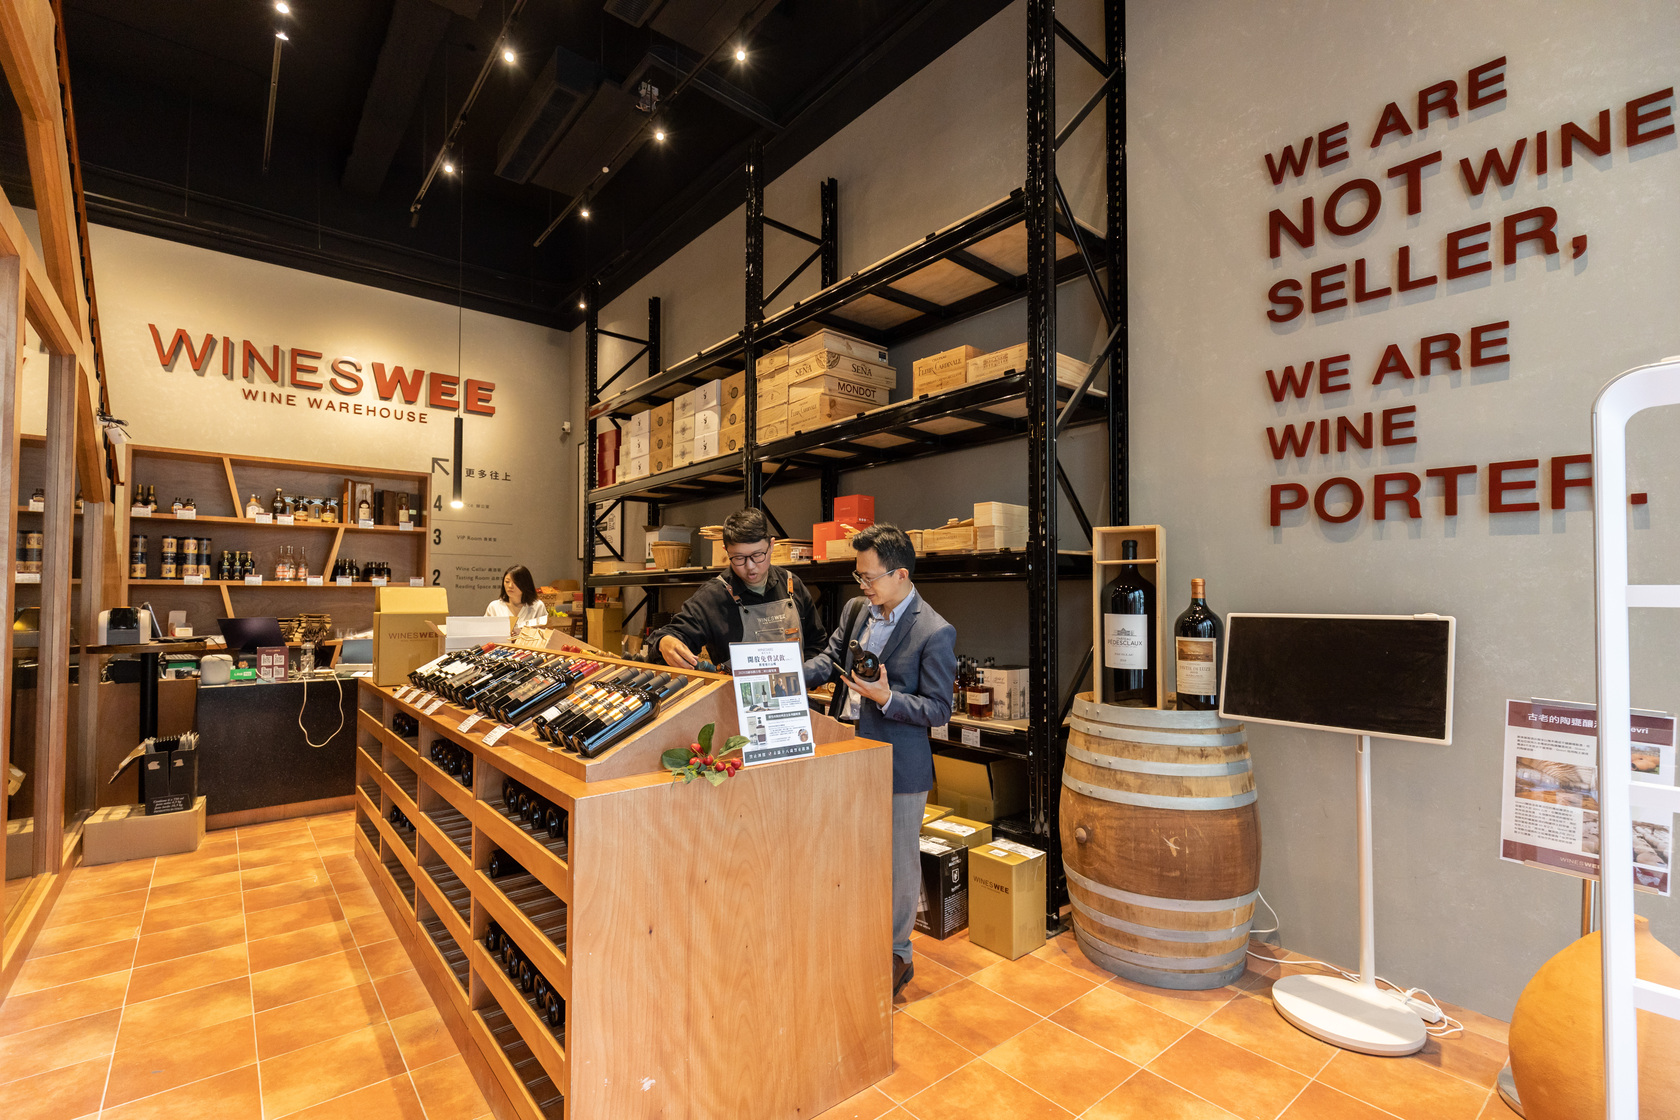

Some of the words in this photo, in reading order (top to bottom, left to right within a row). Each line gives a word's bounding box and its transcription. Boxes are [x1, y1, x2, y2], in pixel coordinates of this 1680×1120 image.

[1264, 122, 1349, 186] WE
[1370, 56, 1507, 148] ARE
[1268, 150, 1442, 259] NOT
[1459, 86, 1675, 196] WINE
[1266, 206, 1588, 323] SELLER,
[148, 323, 496, 415] WINESWEE
[851, 363, 873, 377] SEÑA
[1265, 353, 1351, 402] WE
[1372, 320, 1510, 385] ARE
[837, 382, 877, 399] MONDOT
[242, 388, 297, 406] WINE
[307, 397, 428, 424] WAREHOUSE
[1266, 405, 1417, 460] WINE
[465, 468, 511, 481] 更多往上
[433, 495, 442, 511] 4
[433, 528, 442, 545] 3
[432, 568, 441, 586] 2
[1630, 727, 1649, 735] evri
[973, 875, 1010, 894] WINESWEE
